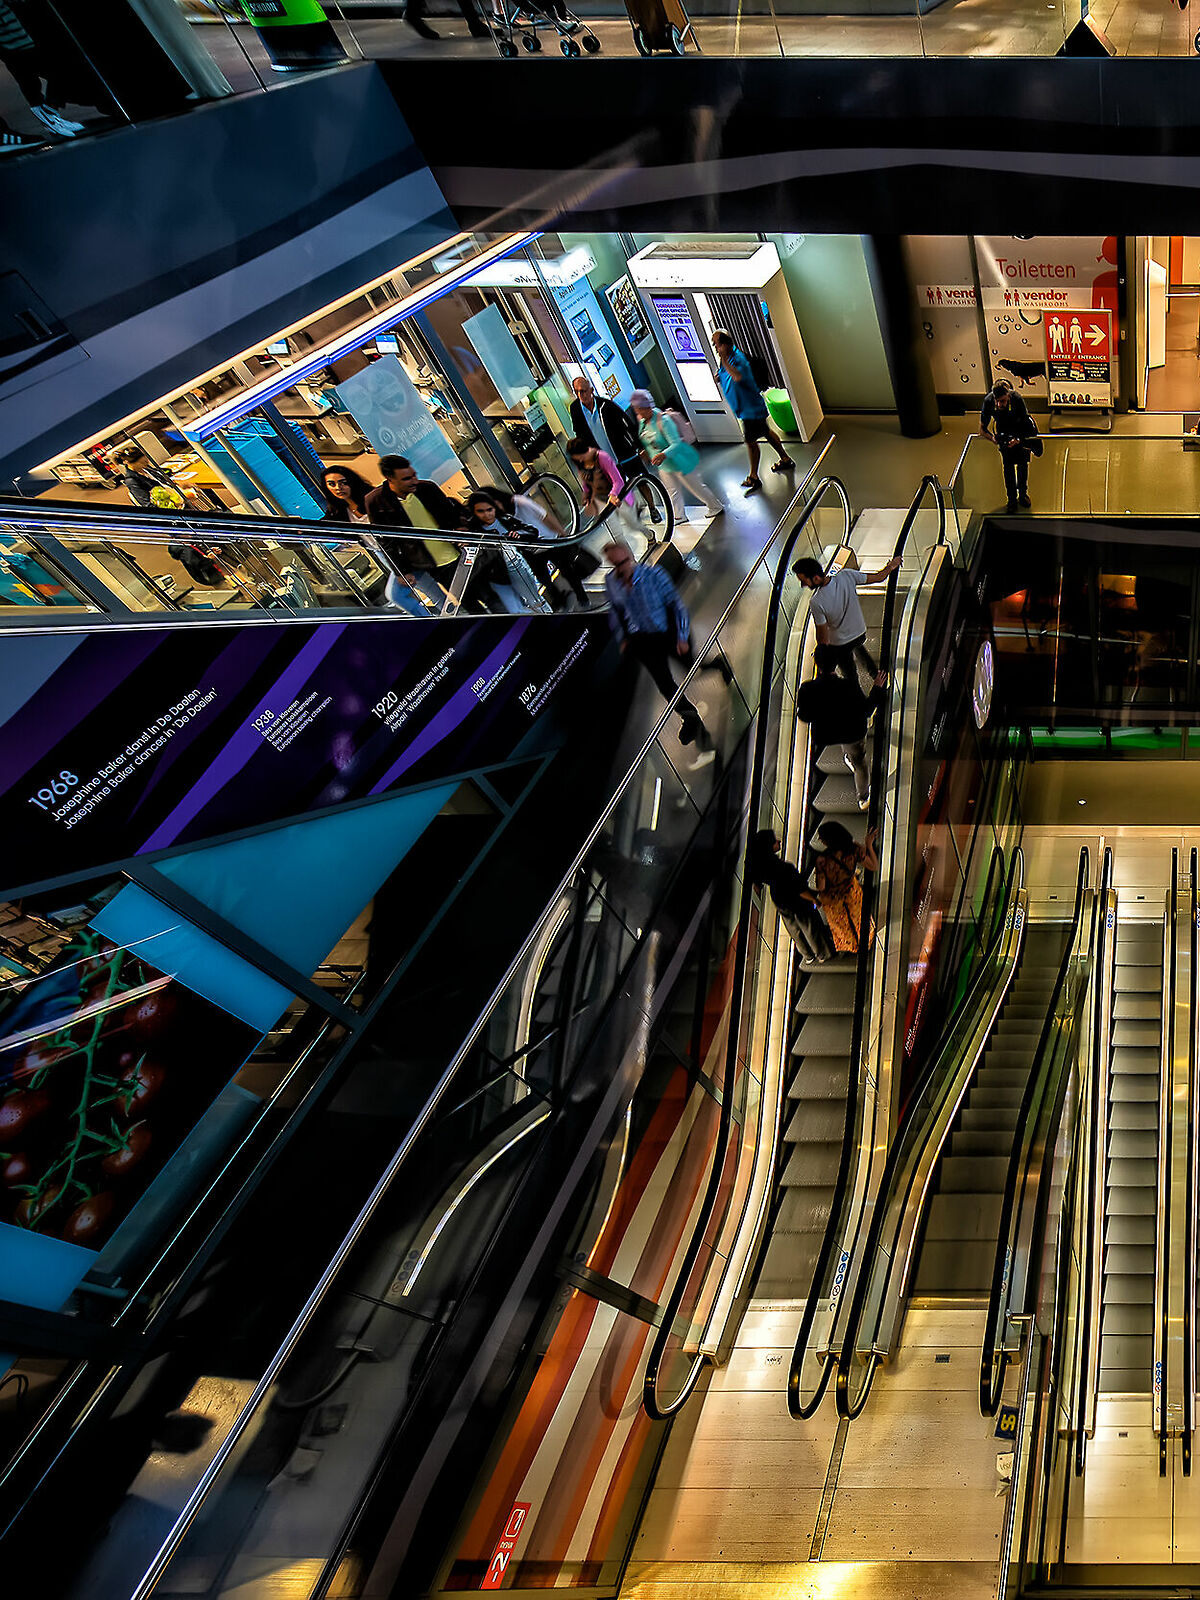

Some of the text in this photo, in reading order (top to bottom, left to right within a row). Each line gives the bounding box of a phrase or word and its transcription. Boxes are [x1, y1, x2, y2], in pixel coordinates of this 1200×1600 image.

[995, 258, 1076, 279] Toiletten
[1022, 290, 1068, 301] vendor
[470, 676, 487, 694] 1908
[518, 682, 537, 705] 1876
[371, 690, 399, 719] 1920
[250, 709, 276, 733] 1938
[276, 729, 301, 753] European
[51, 776, 102, 822] Josephine
[97, 752, 128, 780] Baker
[124, 731, 152, 757] danst
[155, 713, 173, 729] De
[168, 688, 202, 717] Doelen
[28, 770, 79, 811] 1968
[63, 785, 112, 831] Josephine
[106, 762, 137, 789] Baker
[133, 735, 168, 767] dances
